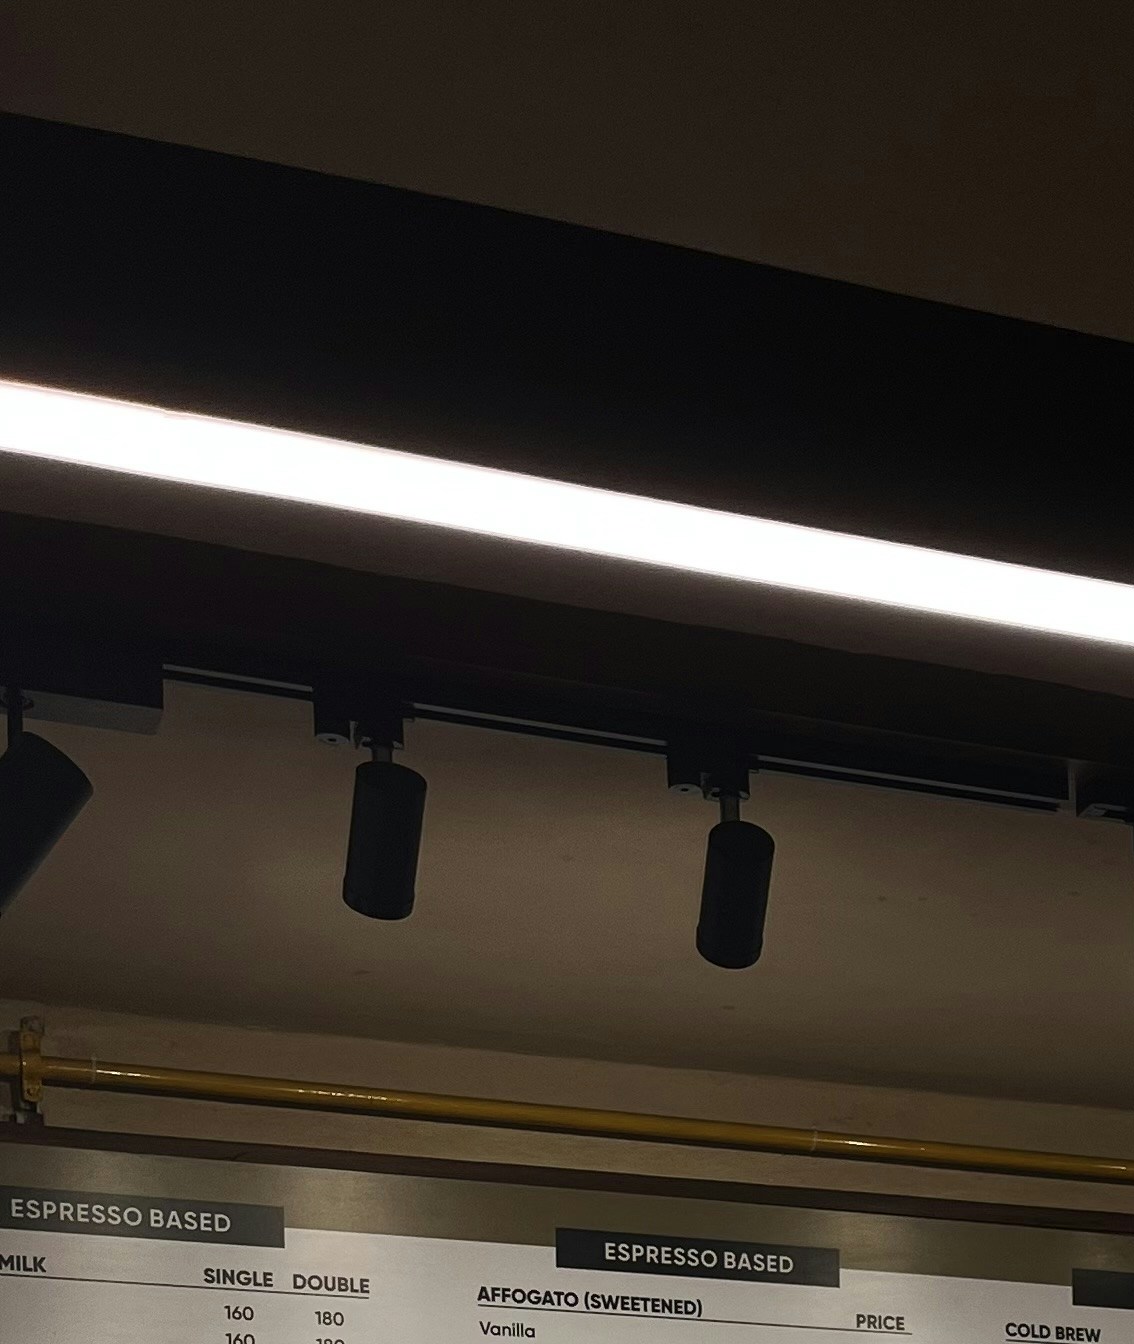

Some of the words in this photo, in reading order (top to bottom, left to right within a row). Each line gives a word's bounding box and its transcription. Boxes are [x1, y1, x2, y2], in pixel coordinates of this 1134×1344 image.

[12, 1199, 142, 1226] ESPRESSO
[150, 1209, 230, 1232] BASED
[605, 1242, 717, 1267] ESPRESSO
[724, 1252, 793, 1273] BASED
[203, 1268, 273, 1287] SINGLE
[293, 1274, 370, 1294] DOUBLE
[224, 1305, 254, 1321] 160
[315, 1311, 344, 1326] 180
[477, 1286, 579, 1307] AFFOGATO
[584, 1291, 702, 1318] (SWEETENED)
[856, 1314, 905, 1331] PRICE
[479, 1321, 535, 1338] Vanilla
[1005, 1322, 1051, 1339] COLD
[1055, 1326, 1101, 1342] BREW
